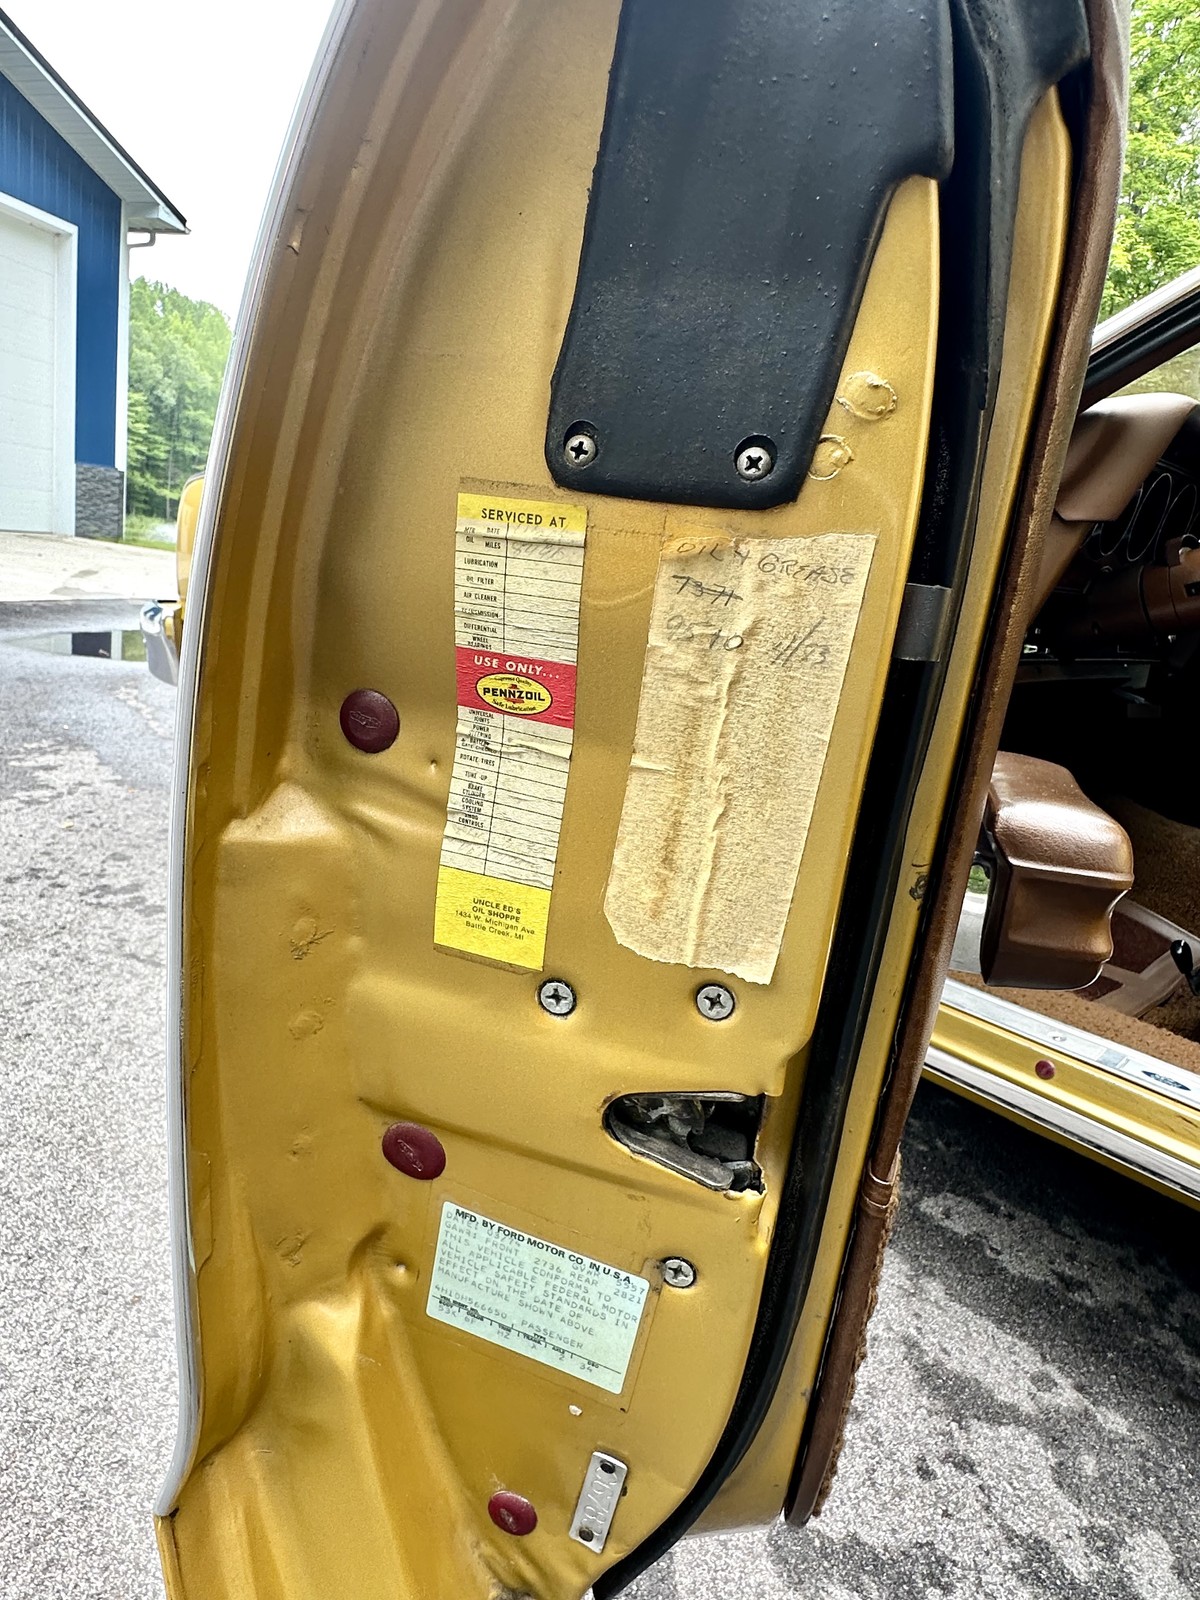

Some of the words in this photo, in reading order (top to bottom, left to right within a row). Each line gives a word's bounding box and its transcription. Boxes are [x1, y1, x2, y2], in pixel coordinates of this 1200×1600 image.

[481, 507, 543, 525] SERVICED
[549, 516, 567, 528] AT
[486, 527, 501, 535] DATE
[484, 541, 501, 550] MILES
[463, 557, 499, 568] LUBRICATION
[676, 542, 725, 562] OIL
[757, 552, 857, 585] GREASE
[476, 576, 495, 585] FILTER
[474, 592, 498, 602] CLEANER
[463, 622, 498, 634] DIFFERENTIAL
[473, 654, 500, 668] USE
[482, 687, 546, 702] PENNZOIL
[472, 724, 490, 732] POWER
[459, 753, 479, 763] ROTATE
[481, 758, 495, 767] TIRES
[461, 797, 484, 807] COOLING
[461, 804, 482, 813] SYSTEM
[458, 817, 484, 828] CONTROLS
[472, 898, 501, 910] UNCLE
[472, 906, 486, 915] OIL
[487, 909, 521, 923] SHOPPE
[465, 920, 487, 932] Battle
[514, 932, 524, 940] MI
[485, 917, 519, 931] Michigan
[455, 1208, 478, 1223] MFD.
[482, 1219, 495, 1232] BY
[497, 1225, 525, 1242] FORD
[526, 1236, 566, 1259] MOTOR
[568, 1254, 586, 1267] CO.
[588, 1260, 601, 1273] IN
[444, 1230, 470, 1246] THIS
[477, 1241, 525, 1268] VEHICLE
[532, 1262, 590, 1294] CONFORMS
[597, 1291, 612, 1302] TO
[485, 1237, 520, 1257] FRONT
[533, 1257, 562, 1274] 2736
[569, 1271, 599, 1287] REAR
[613, 1288, 641, 1305] 2821
[441, 1239, 461, 1253] ALL
[468, 1250, 538, 1284] APPLICABLE
[544, 1279, 593, 1306] FEDERAL
[601, 1301, 638, 1323] MOTOR
[438, 1257, 478, 1279] EFFECT
[485, 1276, 500, 1287] ON
[506, 1283, 526, 1298] THE
[533, 1296, 561, 1313] DATE
[568, 1309, 583, 1320] OF
[440, 1249, 488, 1272] VEHICLE
[494, 1269, 535, 1292] SAFETY
[542, 1289, 607, 1321] STANDARDS
[614, 1318, 629, 1330] IN
[437, 1266, 511, 1303] MANUFACTURE
[518, 1299, 554, 1319] SHOWN
[559, 1316, 595, 1336] ABOVE
[520, 1319, 584, 1349] PASSENGER
